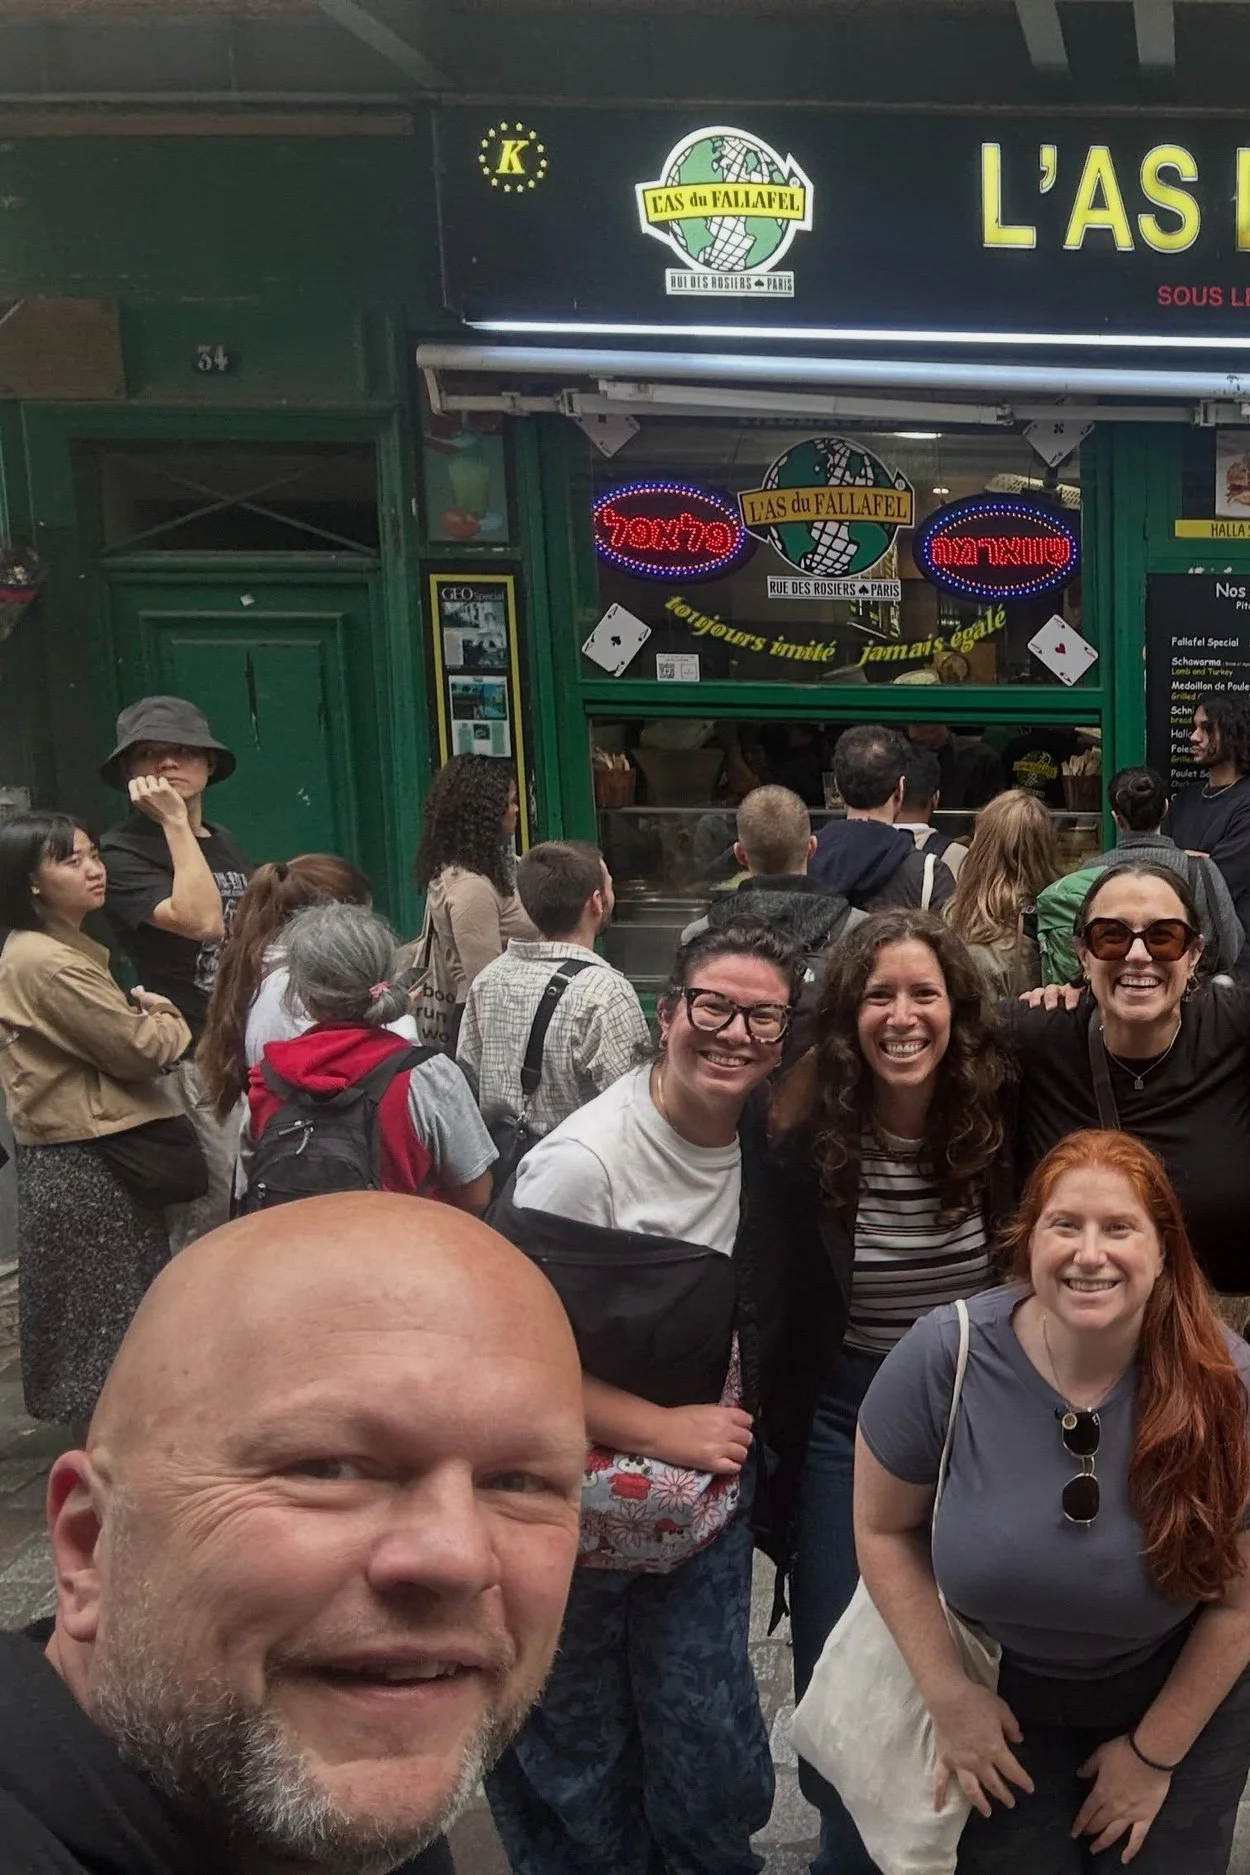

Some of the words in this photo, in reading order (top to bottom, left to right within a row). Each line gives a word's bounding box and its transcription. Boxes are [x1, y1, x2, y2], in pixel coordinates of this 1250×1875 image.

[499, 140, 529, 175] K
[651, 193, 685, 214] L'AS
[690, 192, 708, 207] du
[711, 190, 801, 212] FALLAFEL
[980, 143, 1201, 254] L'AS
[671, 275, 687, 289] RUE
[691, 275, 709, 289] DES
[712, 276, 752, 290] ROSIERS
[767, 277, 793, 291] PARIS
[1157, 286, 1222, 308] SOUS
[750, 496, 786, 523] L'AS
[791, 491, 811, 513] du
[814, 491, 907, 519] FALLAFEL
[602, 508, 732, 554] פלאפל
[1211, 523, 1245, 537] HALLA
[931, 536, 1071, 566] שווארמה
[770, 581, 788, 595] RUE
[792, 582, 811, 595] DES
[814, 582, 856, 596] ROSIERS
[871, 583, 900, 597] PARIS
[1215, 583, 1246, 598] Nos
[664, 596, 767, 651] toujours
[769, 635, 837, 662] imité
[854, 633, 944, 667] jamais
[950, 603, 1007, 653] égalé
[1171, 636, 1205, 647] Fallafel
[1207, 638, 1239, 648] Special
[1171, 657, 1221, 667] Schawarma
[1171, 668, 1191, 676] Lamb
[1192, 668, 1206, 676] and
[1208, 668, 1234, 677] Turkey
[1171, 681, 1213, 690] Medaillon
[1214, 681, 1225, 691] de
[1171, 692, 1196, 701] Grilled
[1171, 769, 1197, 777] Poulet
[416, 1006, 447, 1023] run
